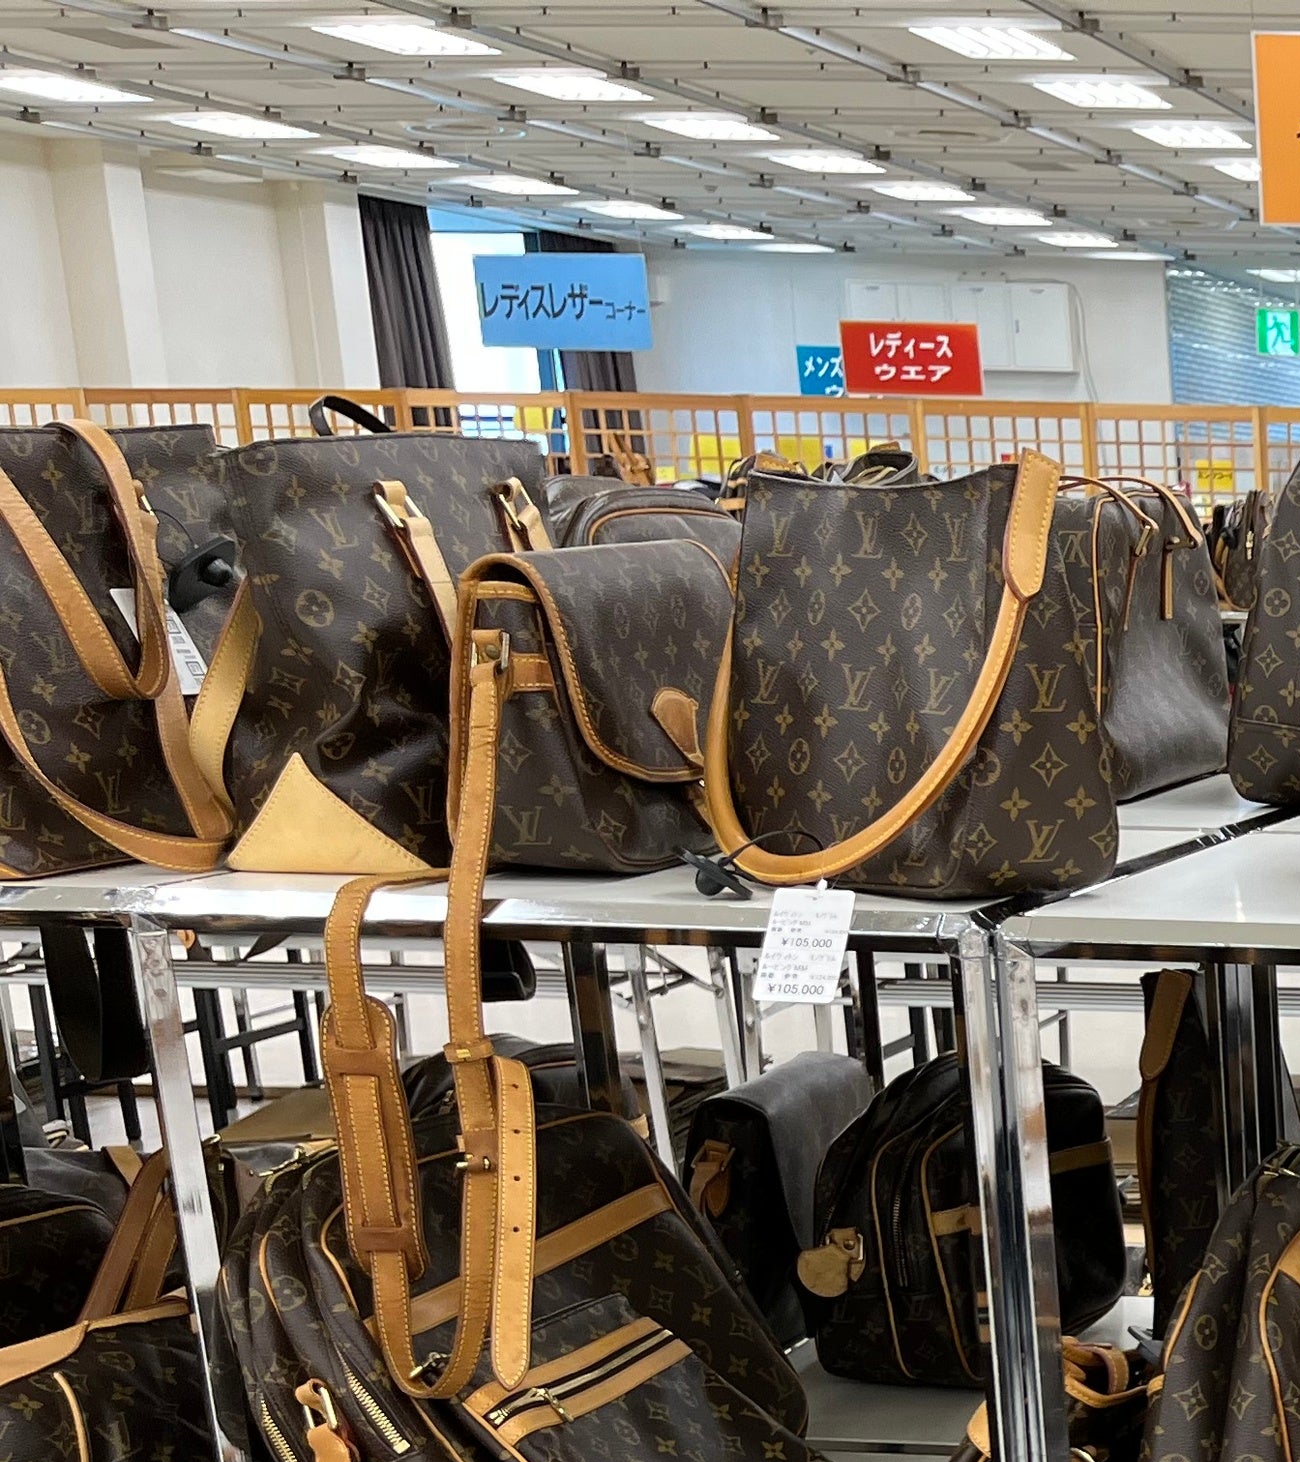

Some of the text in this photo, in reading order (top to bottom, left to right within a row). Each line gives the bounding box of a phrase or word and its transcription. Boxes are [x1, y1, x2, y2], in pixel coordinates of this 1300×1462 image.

[869, 331, 953, 359] レディース
[874, 363, 952, 382] ウエア
[767, 983, 825, 996] ¥105,000
